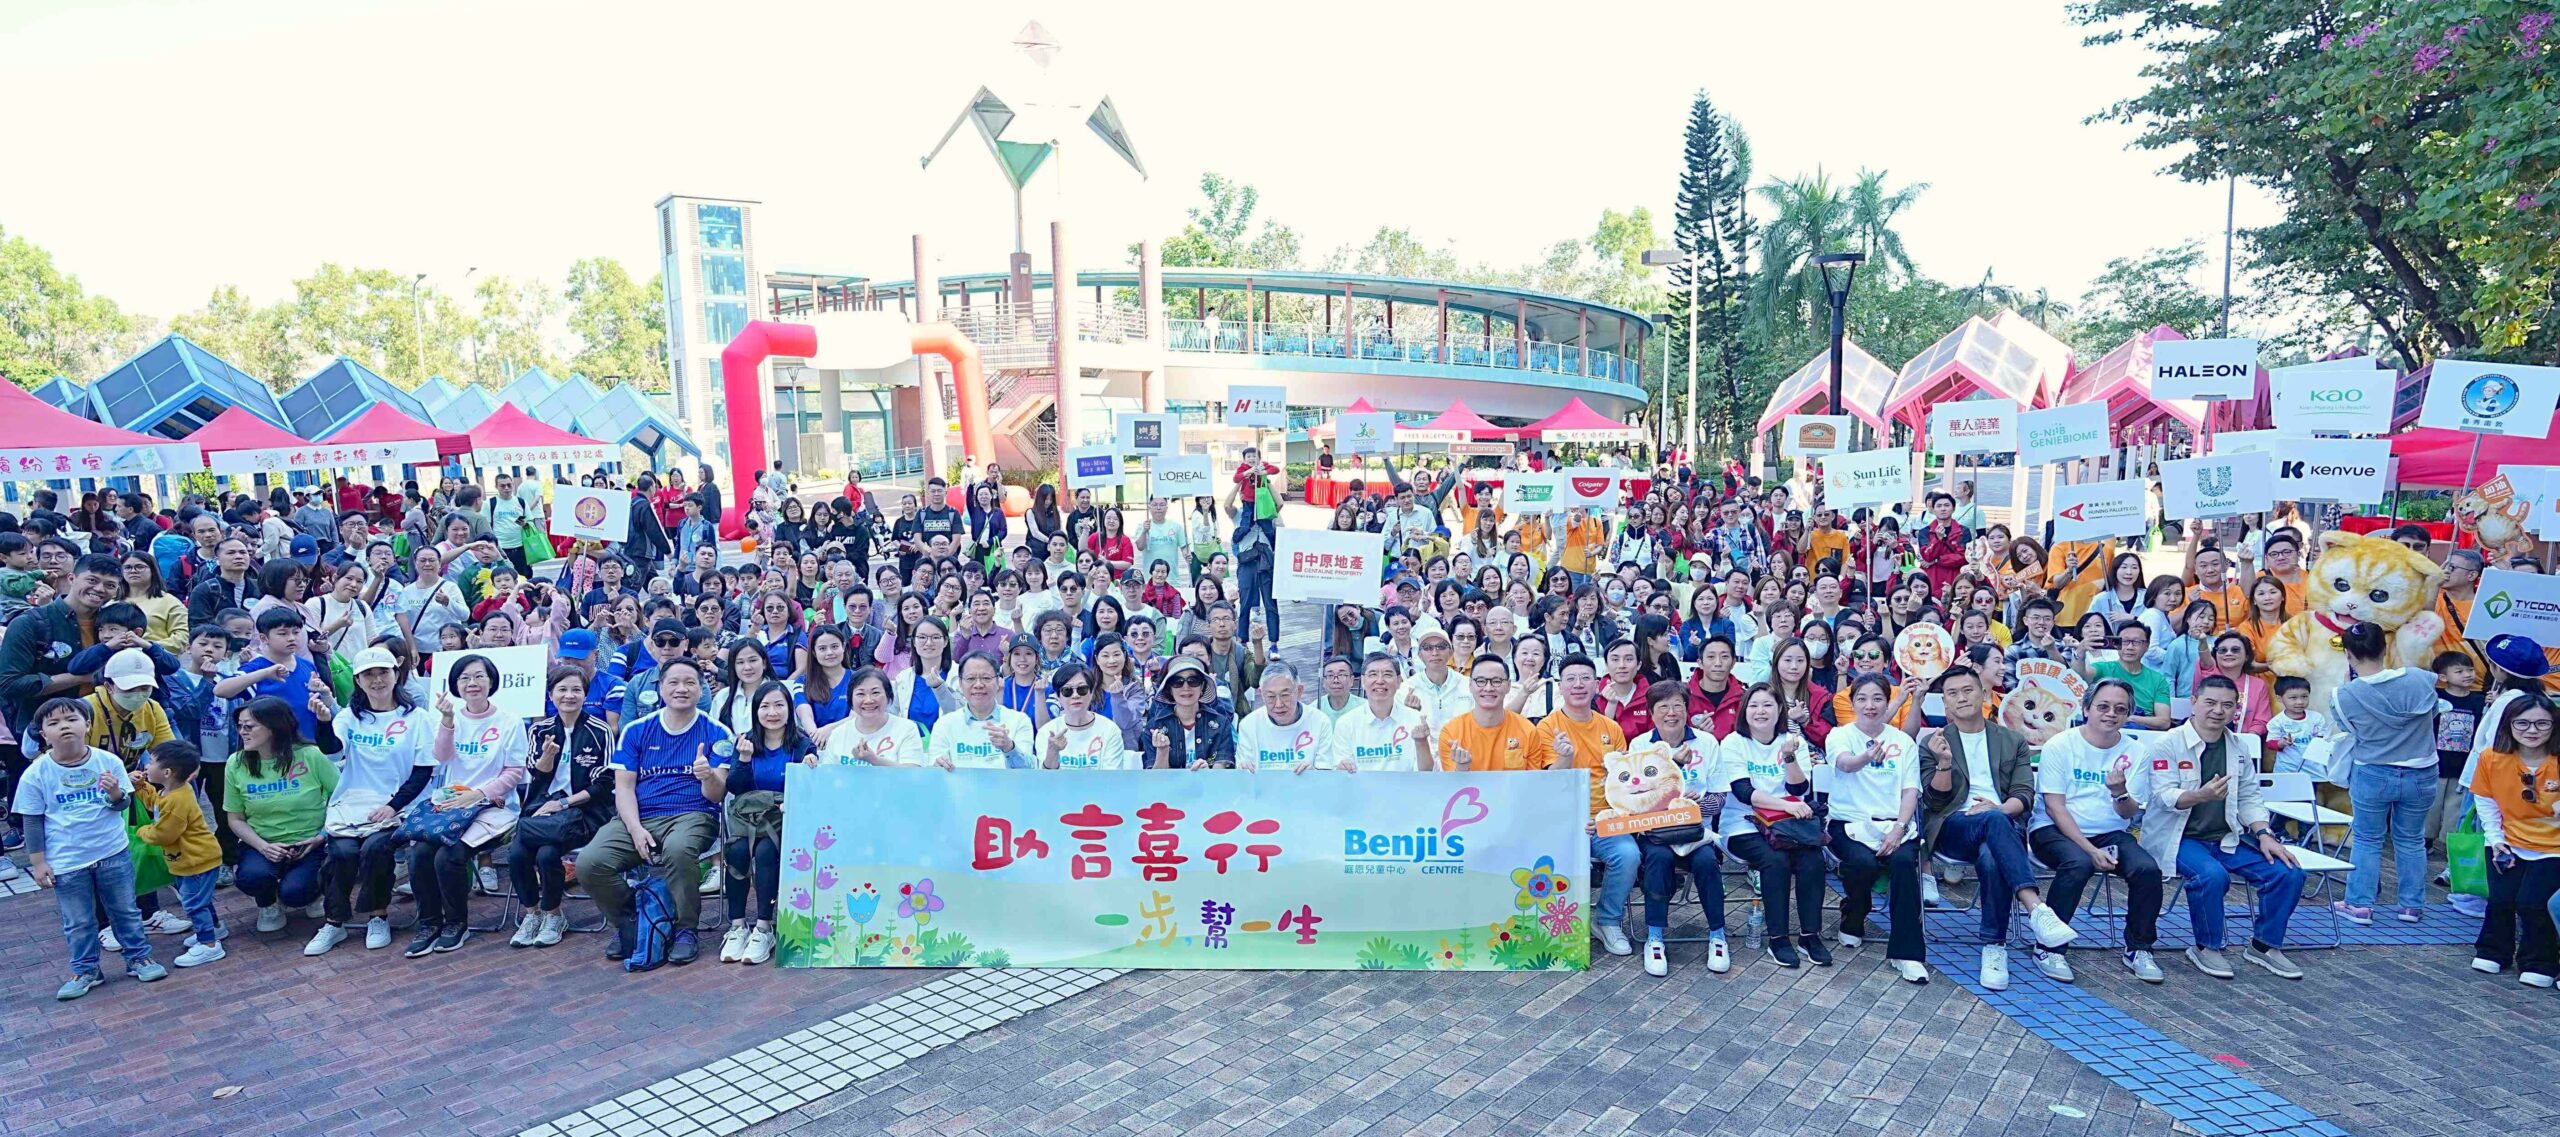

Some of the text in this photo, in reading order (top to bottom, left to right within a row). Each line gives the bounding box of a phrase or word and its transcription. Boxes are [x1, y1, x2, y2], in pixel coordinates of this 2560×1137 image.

[2158, 364, 2247, 378] HALEON
[2030, 430, 2099, 448] GENIEBIOME
[1853, 466, 1901, 481] Sun Life
[1527, 487, 1550, 495] DARLIE
[1578, 480, 1604, 490] Colgate
[2195, 498, 2236, 509] Unilever
[924, 520, 951, 528] adidas
[1304, 552, 1364, 570] 中原地產
[2515, 599, 2560, 613] TYCOON
[502, 672, 536, 690] Bär
[1628, 810, 1692, 829] mannings
[970, 802, 1283, 883] 助言喜行
[1343, 827, 1465, 864] Benji's
[1421, 864, 1465, 874] CENTRE
